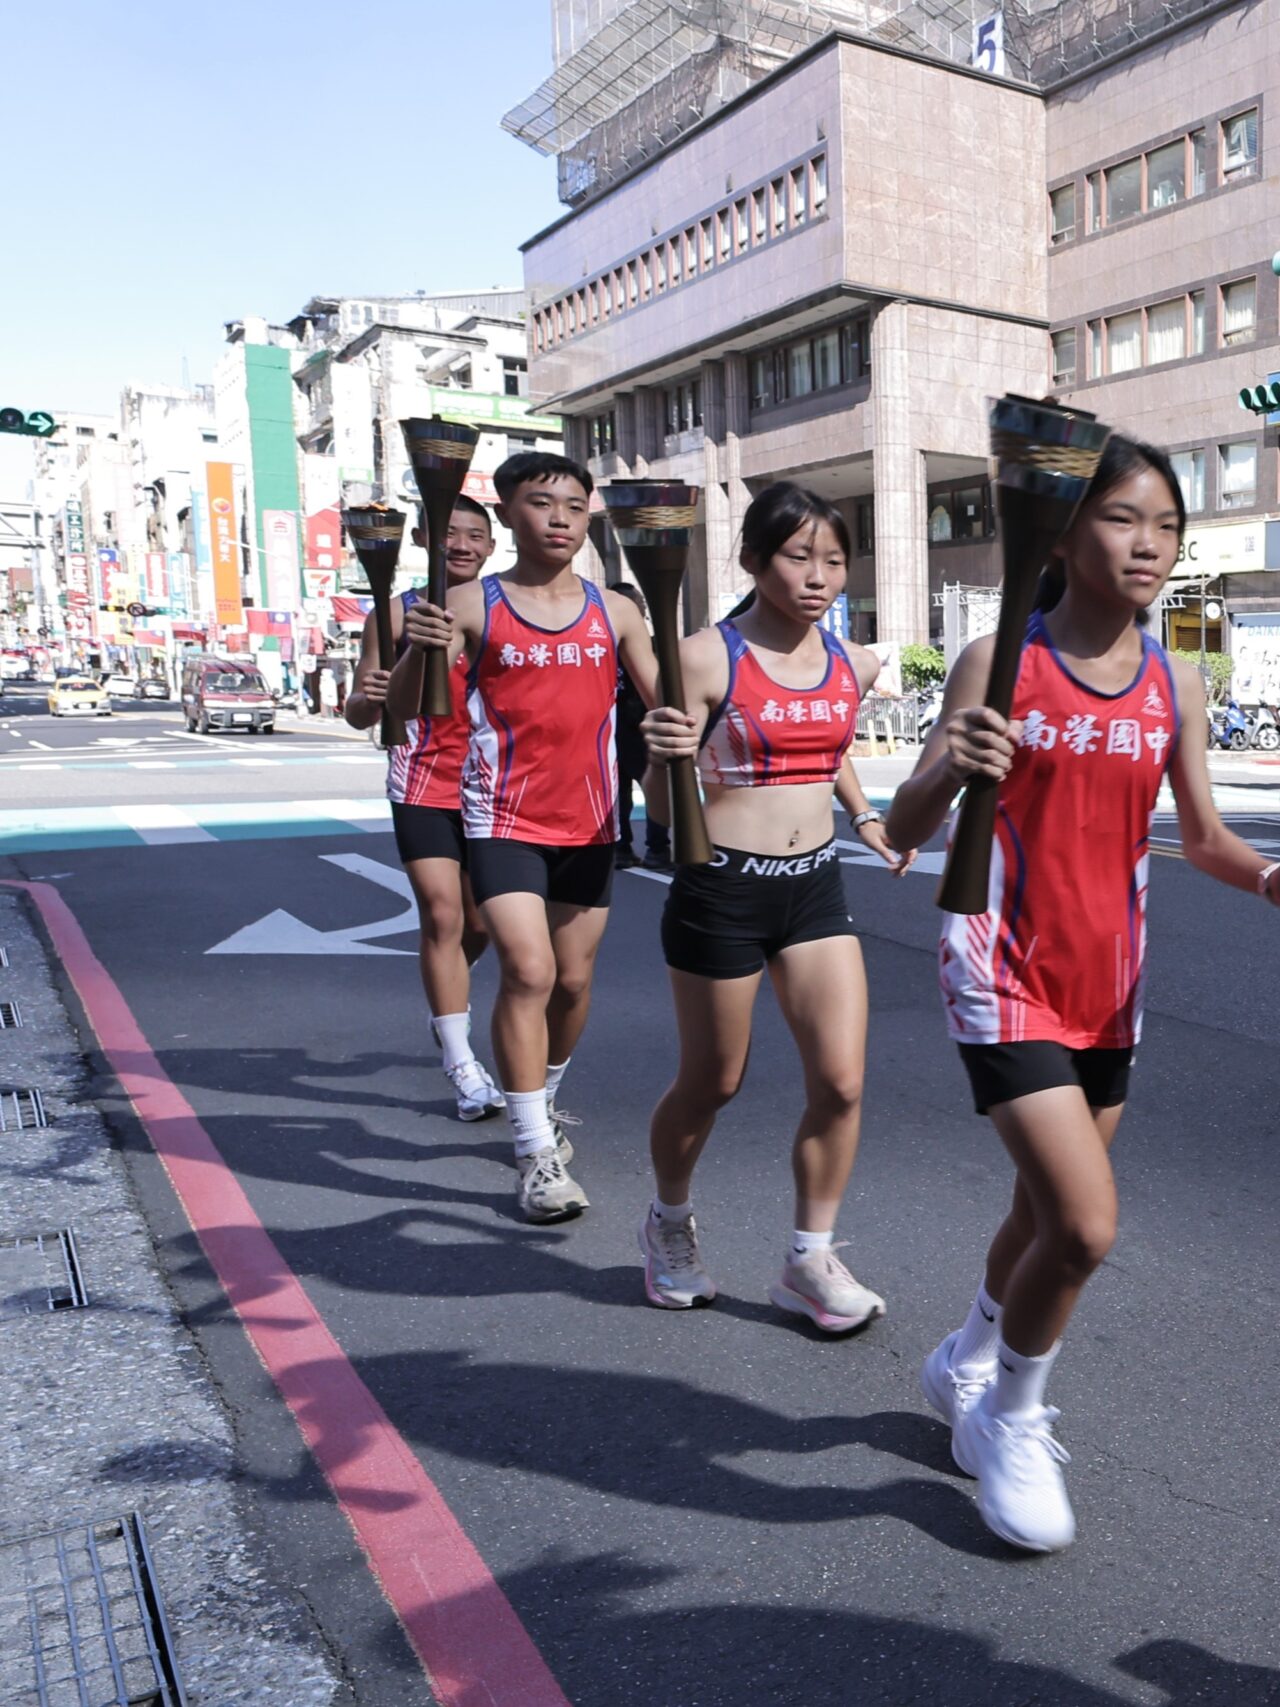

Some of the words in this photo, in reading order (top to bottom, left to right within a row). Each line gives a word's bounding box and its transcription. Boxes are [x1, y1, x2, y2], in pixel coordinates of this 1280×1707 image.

[978, 18, 996, 71] 5
[500, 643, 607, 668] 南榮國中
[760, 699, 850, 723] 南榮國中
[1018, 709, 1170, 765] 南榮國中
[741, 856, 814, 877] NIKE
